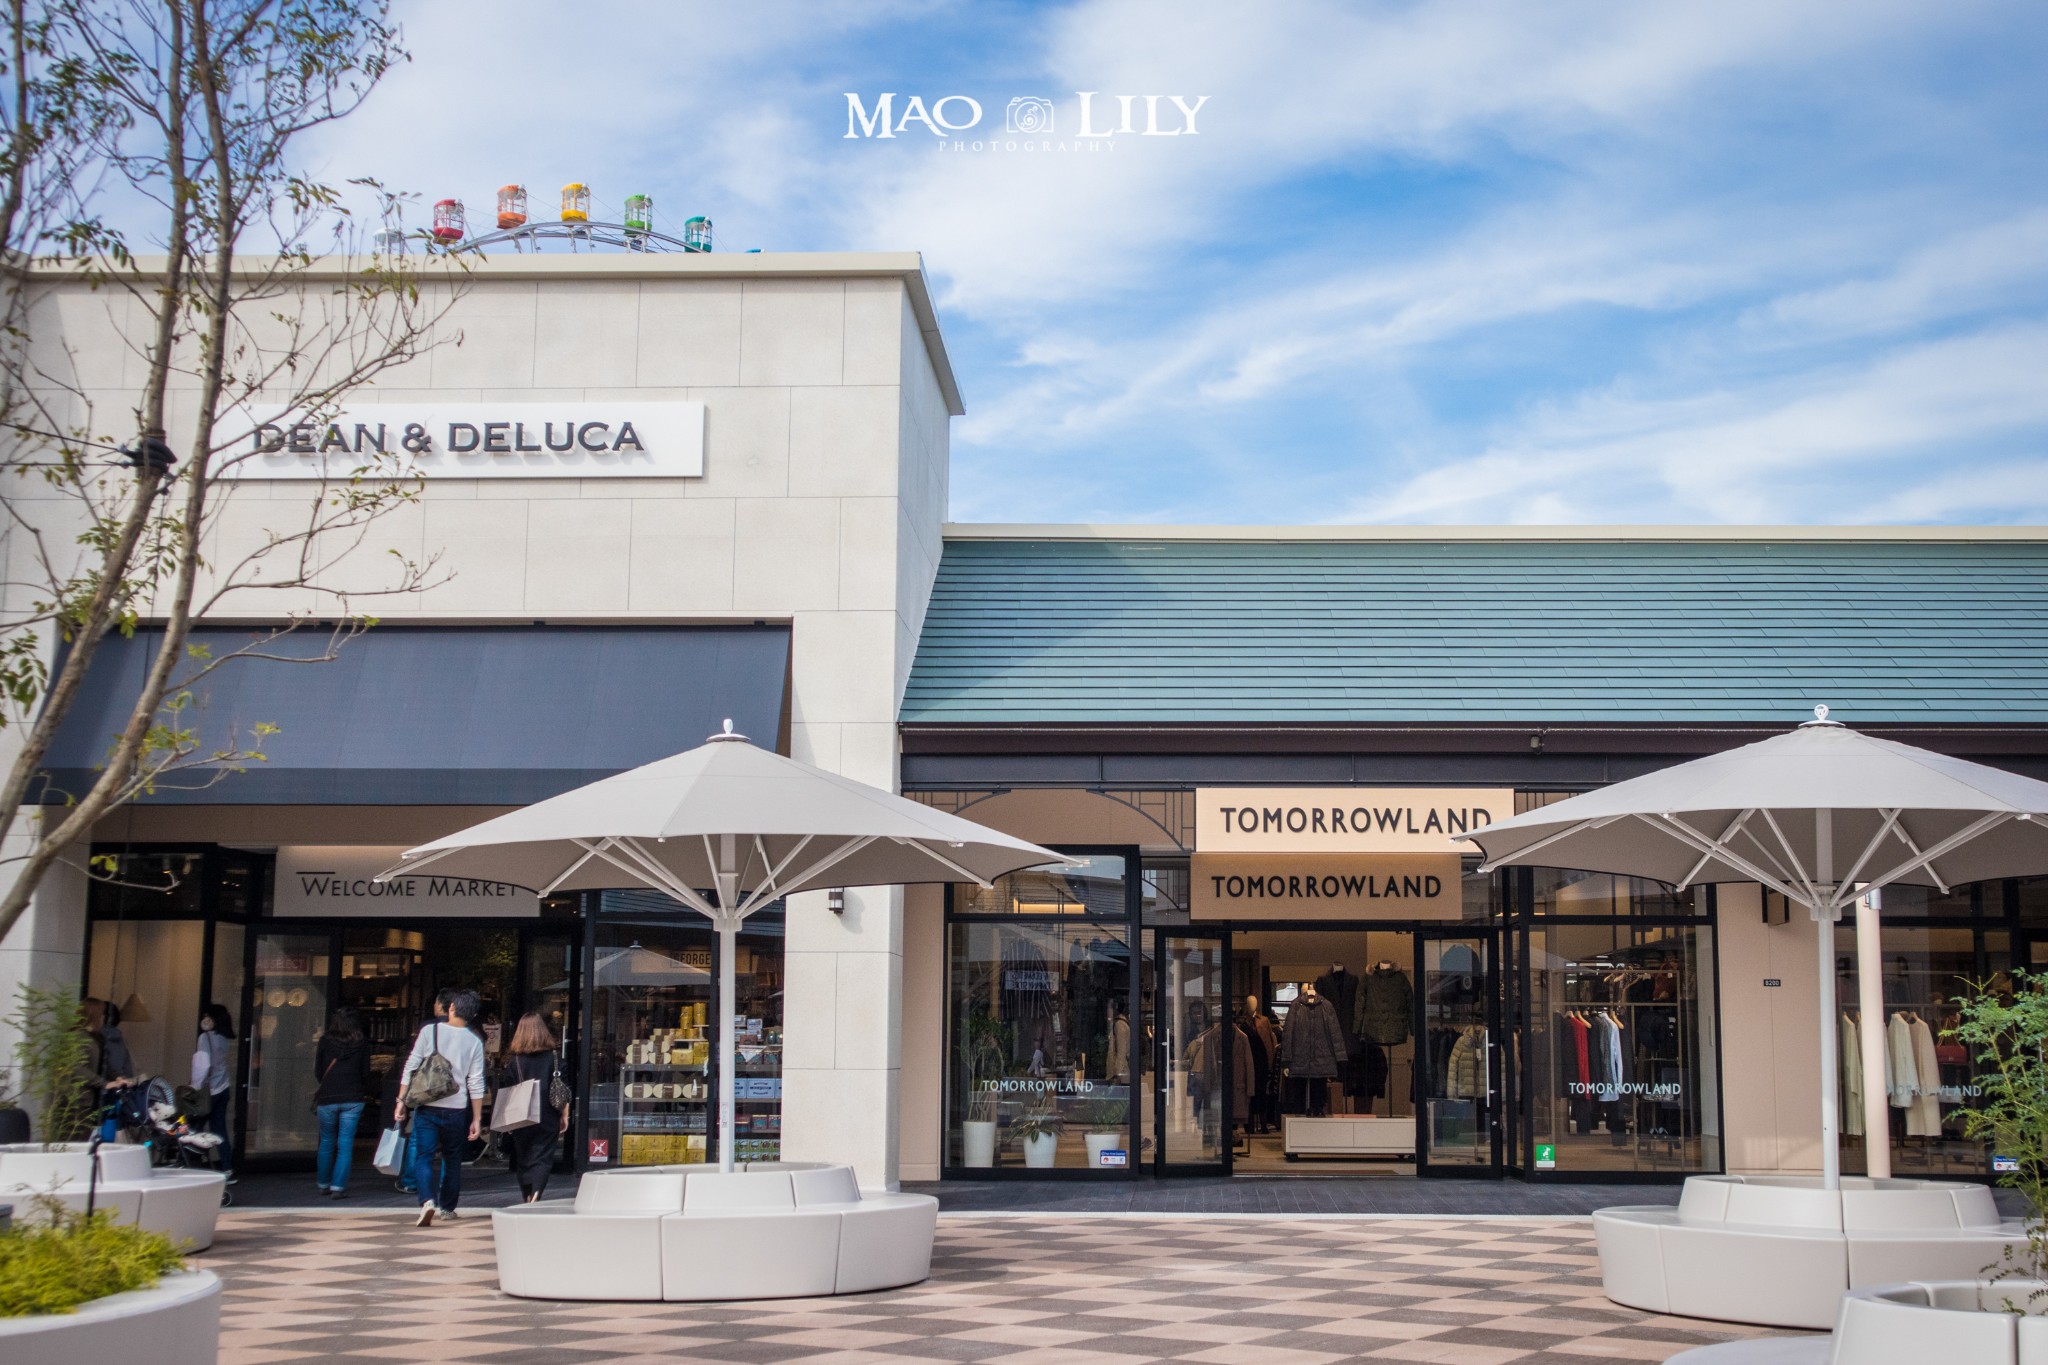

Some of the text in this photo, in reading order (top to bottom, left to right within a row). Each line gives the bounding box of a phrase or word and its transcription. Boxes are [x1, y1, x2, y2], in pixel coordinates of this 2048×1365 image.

[253, 421, 645, 453] DEAN & DELUCA
[1220, 807, 1492, 834] TOMORROWLAND
[301, 876, 415, 897] WELCOME
[1211, 875, 1442, 898] TOMORROWLAND
[982, 1080, 1094, 1093] TOMORROWLAND
[1568, 1082, 1681, 1095] TOMORROWLAND
